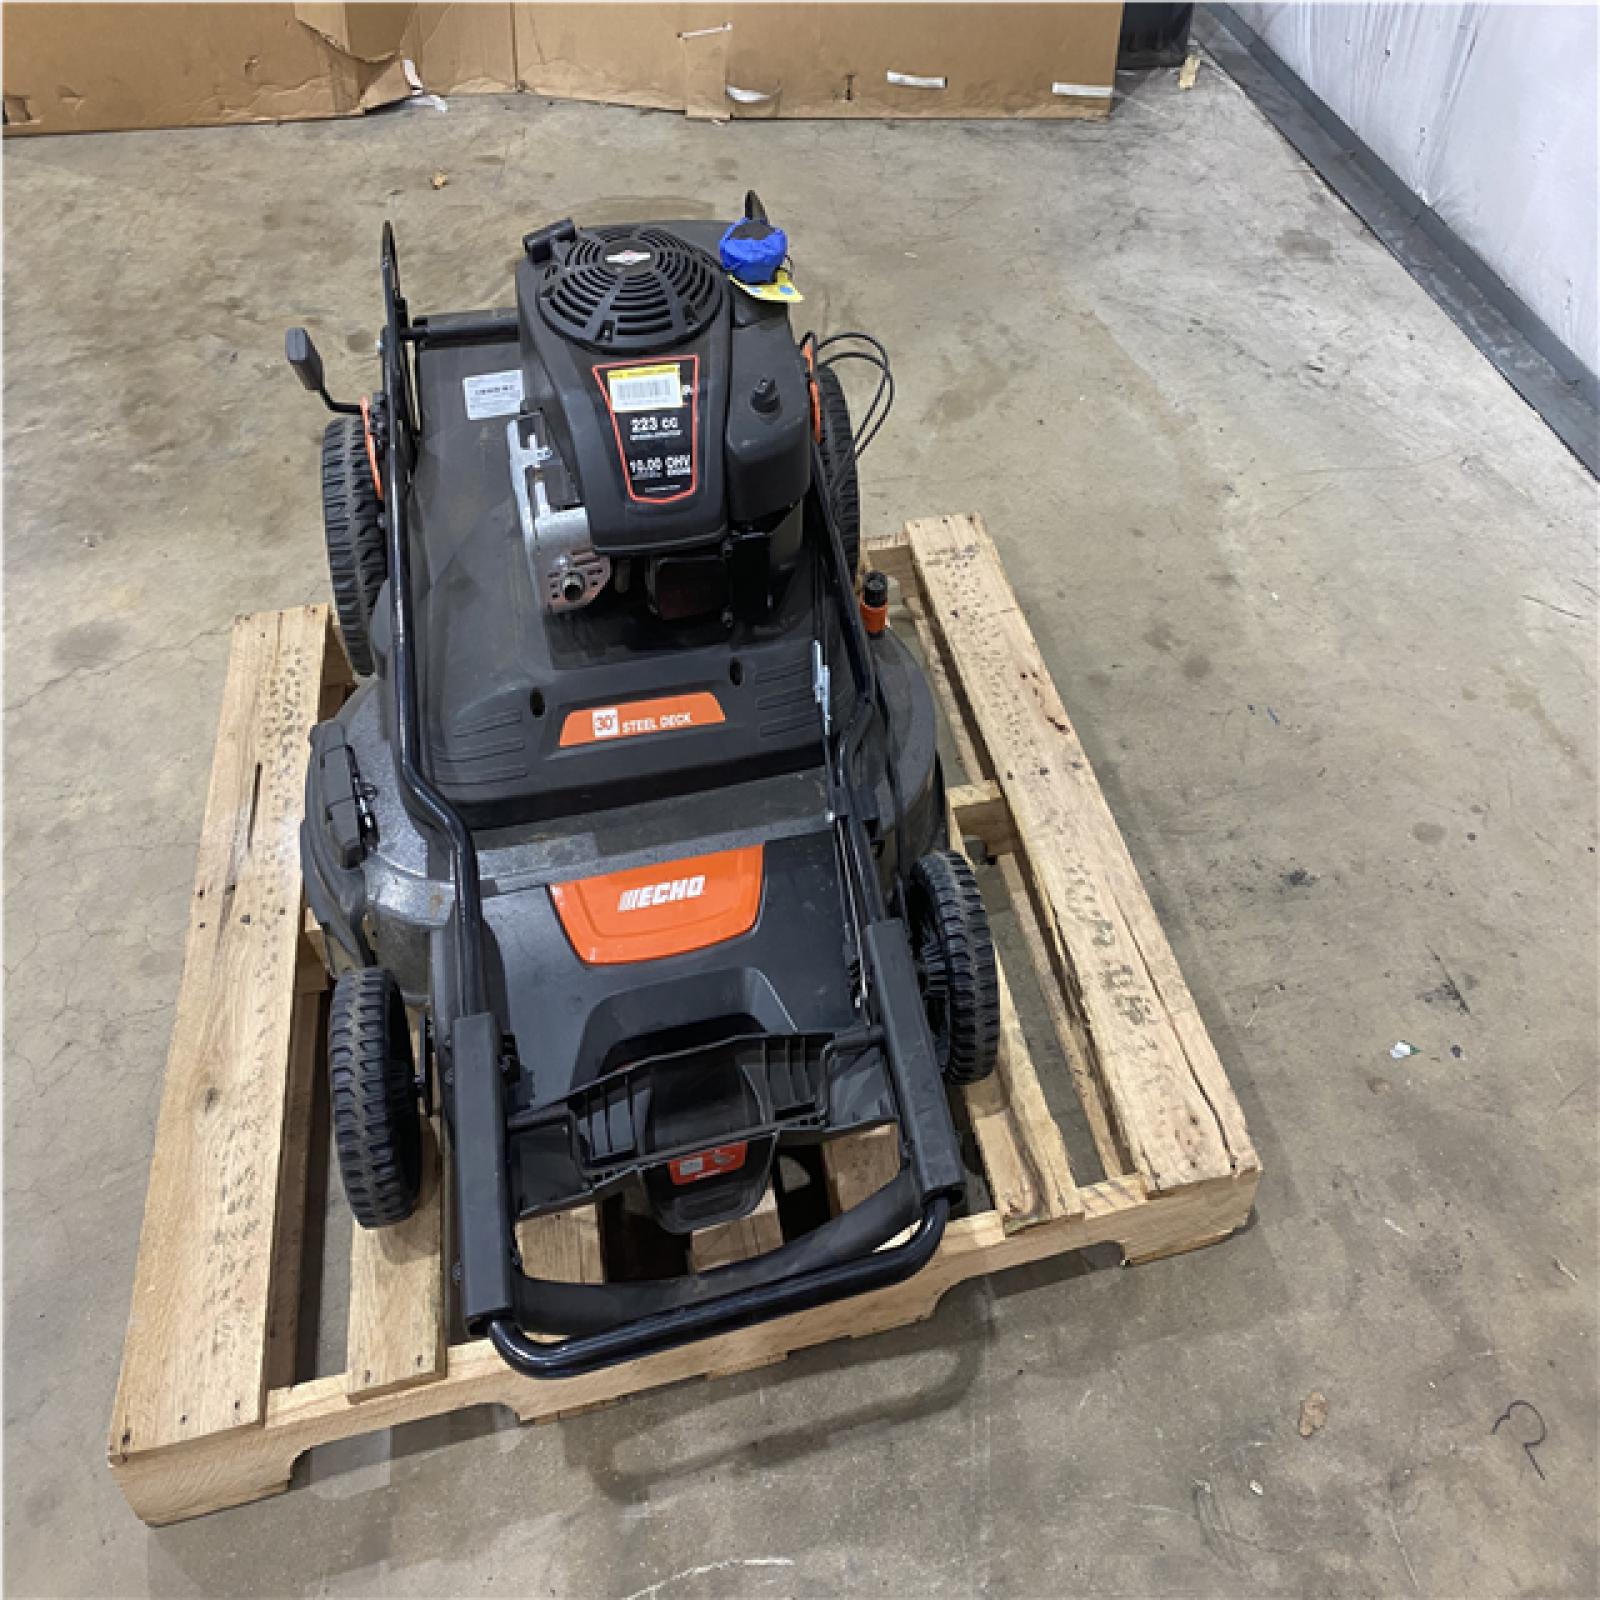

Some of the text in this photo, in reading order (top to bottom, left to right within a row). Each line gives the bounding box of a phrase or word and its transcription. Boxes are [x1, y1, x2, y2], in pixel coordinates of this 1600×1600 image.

[630, 416, 658, 432] 223
[622, 718, 657, 734] STEEL
[660, 712, 692, 729] DECK
[637, 875, 705, 908] ECHO
